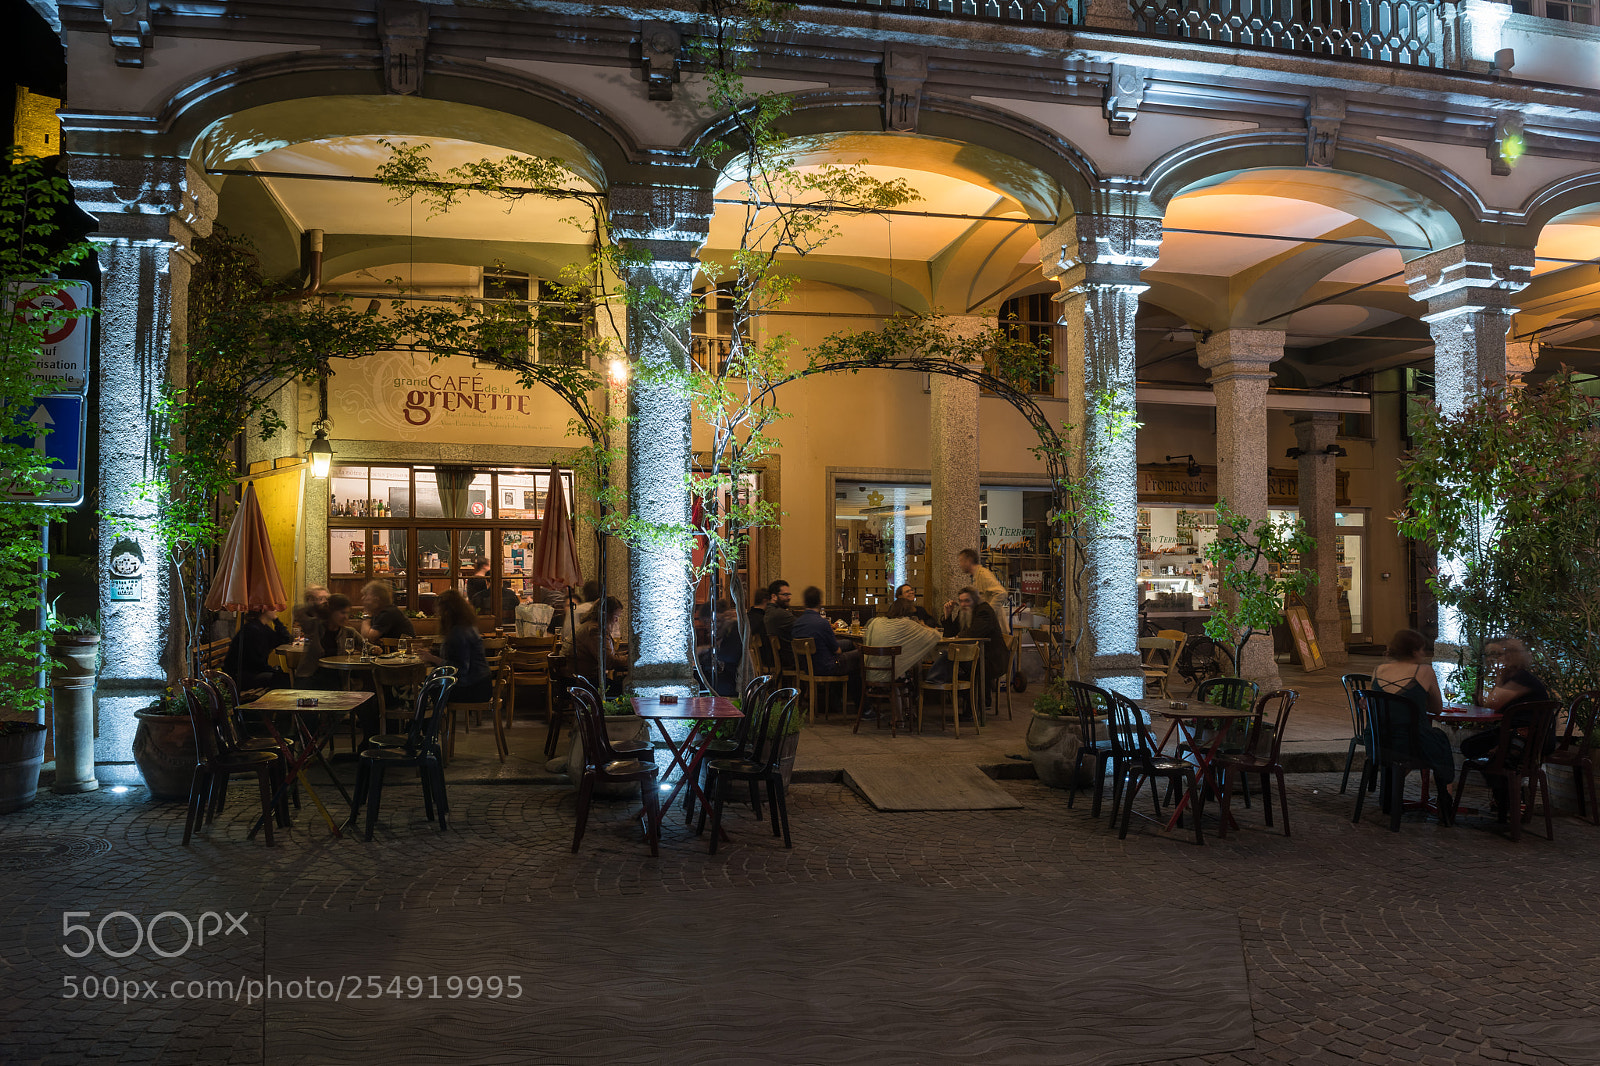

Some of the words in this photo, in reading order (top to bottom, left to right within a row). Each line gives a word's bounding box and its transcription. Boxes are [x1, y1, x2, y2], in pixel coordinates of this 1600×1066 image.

[25, 373, 74, 383] mmunale
[394, 377, 428, 388] grand
[428, 372, 484, 393] CAFÉ
[484, 384, 498, 393] de
[501, 384, 510, 394] la
[1145, 473, 1209, 496] Fromagerie
